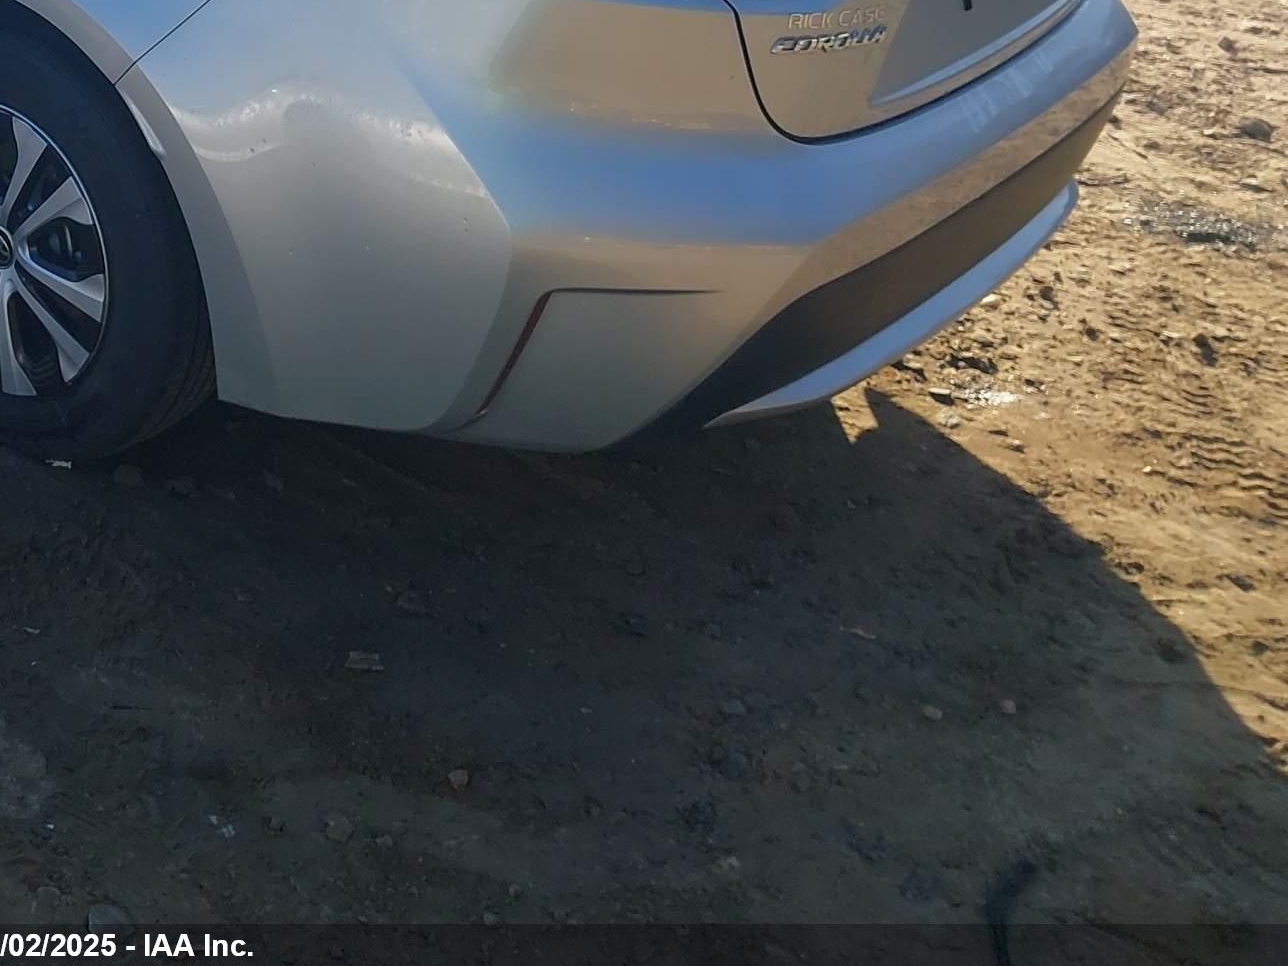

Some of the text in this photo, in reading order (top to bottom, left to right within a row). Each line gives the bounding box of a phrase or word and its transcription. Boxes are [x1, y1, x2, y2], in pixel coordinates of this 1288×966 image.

[787, 7, 886, 30] RICK CASE
[770, 24, 888, 54] COROLLA
